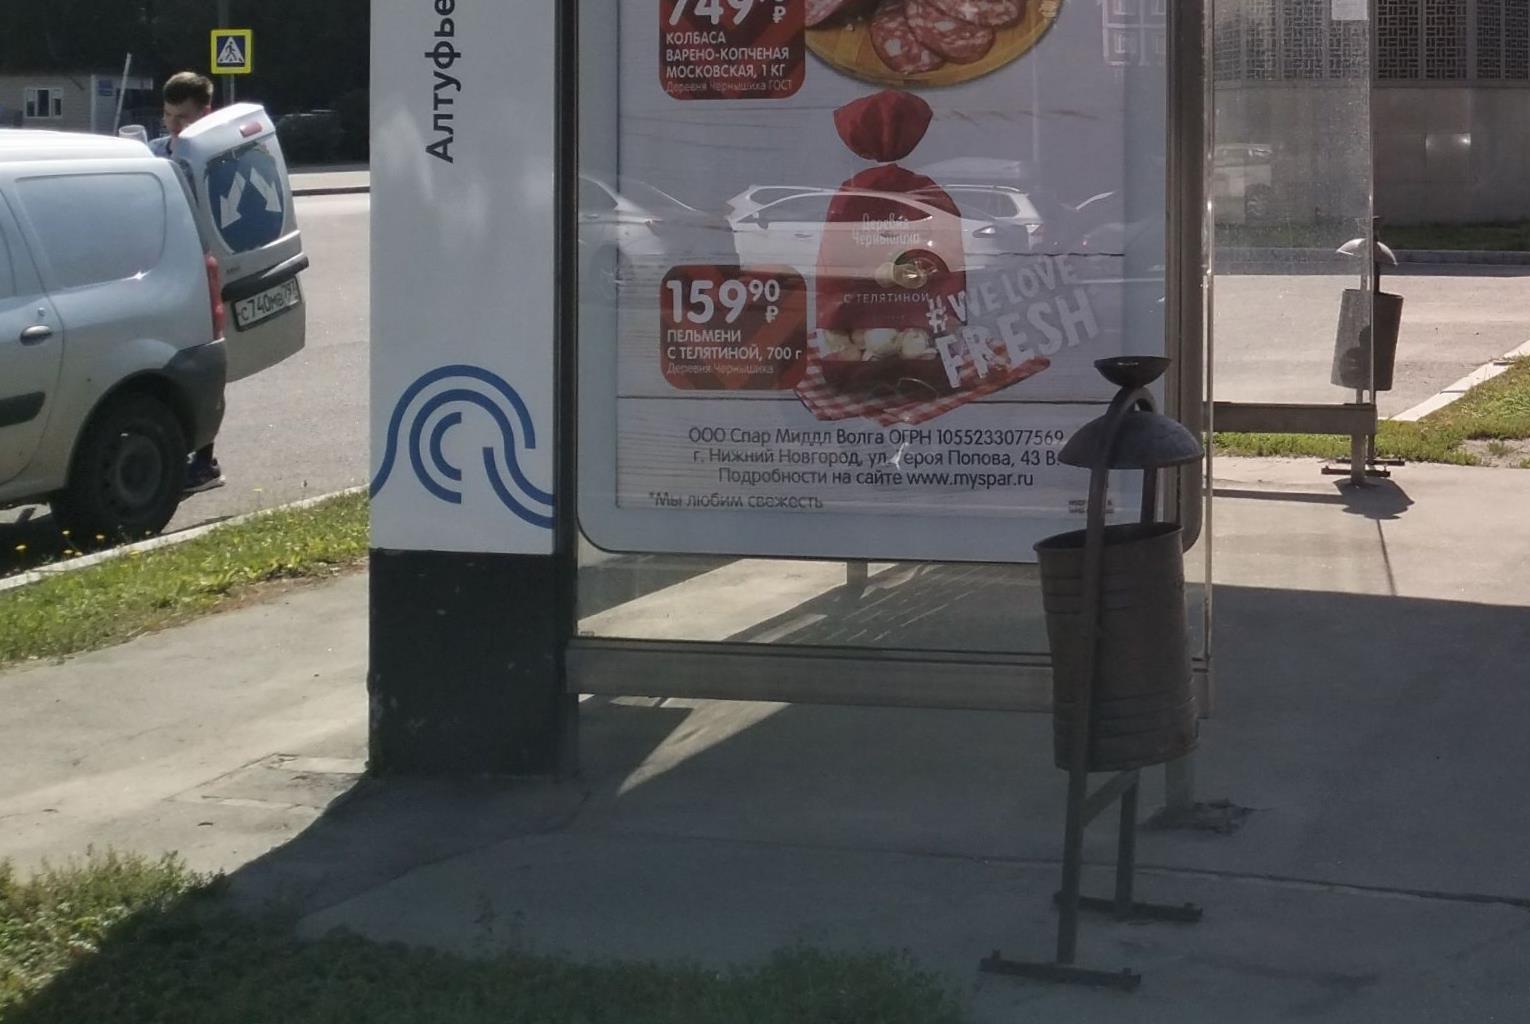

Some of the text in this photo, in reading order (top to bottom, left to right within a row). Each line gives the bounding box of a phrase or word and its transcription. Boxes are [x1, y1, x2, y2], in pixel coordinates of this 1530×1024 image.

[666, 32, 726, 45] КОЛБАСА
[666, 47, 789, 61] ВАРЕНО-КОПЧЕНАЯ
[667, 64, 757, 79] МОСКОВСКАЯ,
[771, 64, 786, 76] КГ
[769, 80, 792, 90] ГОСТ
[1001, 254, 1077, 305] LOVE
[667, 279, 747, 324] 159
[667, 329, 741, 343] ПЕЛЬМЕНИ
[667, 347, 677, 359] С
[680, 344, 762, 362] ТЕЛЯТИНОЙ,
[767, 347, 792, 359] 700
[688, 427, 1064, 447] ООО Спар Миддл Волга ОГРН 1055233077569
[709, 448, 774, 464] Нижний
[779, 450, 863, 467] Новгород,
[894, 450, 944, 468] ероя
[948, 450, 1015, 467] Попова,
[1020, 451, 1041, 466] 43
[718, 468, 1034, 490] Подробности на сайте www.myspar.ru
[686, 492, 744, 508] любим
[747, 495, 824, 509] свежесть
